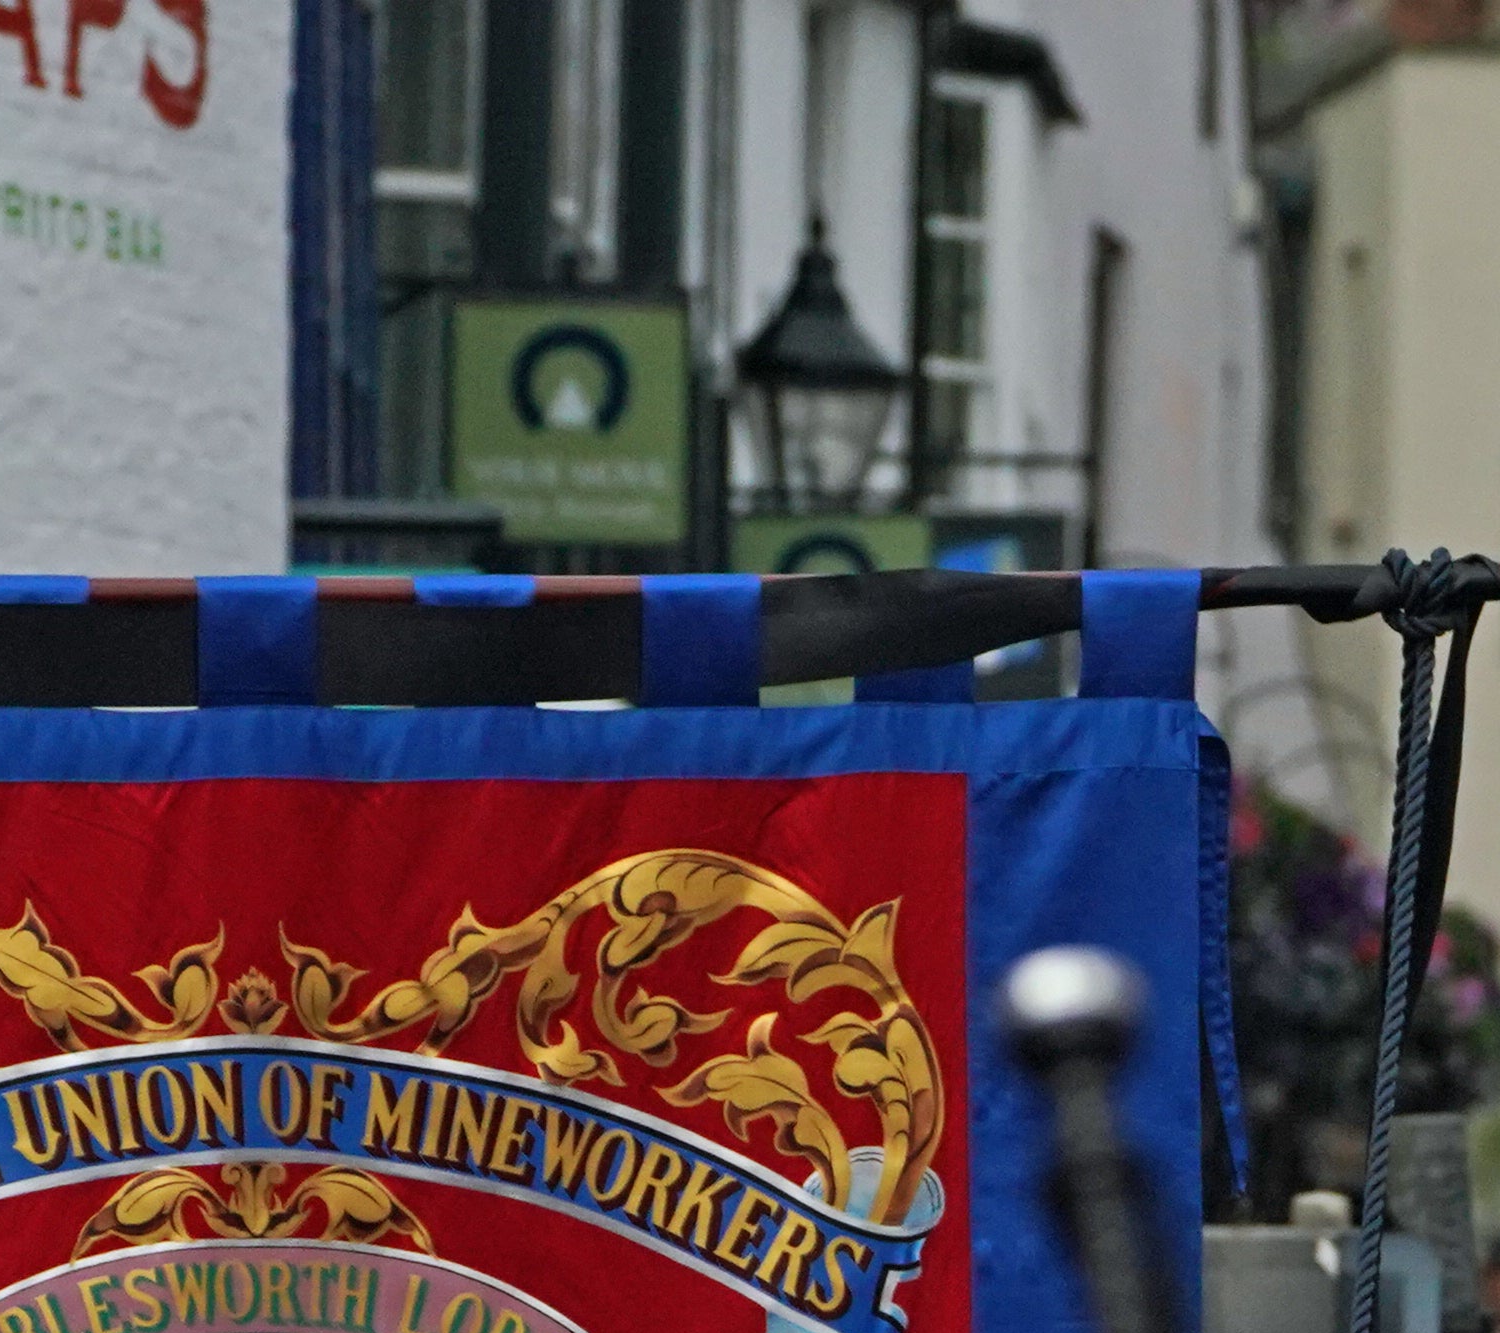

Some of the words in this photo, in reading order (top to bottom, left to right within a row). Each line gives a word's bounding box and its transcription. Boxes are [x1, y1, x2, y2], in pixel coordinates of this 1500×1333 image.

[104, 207, 164, 267] BAR
[3, 1060, 244, 1170] UNION
[259, 1060, 353, 1150] OF
[361, 1072, 872, 1321] MINEWORKERS
